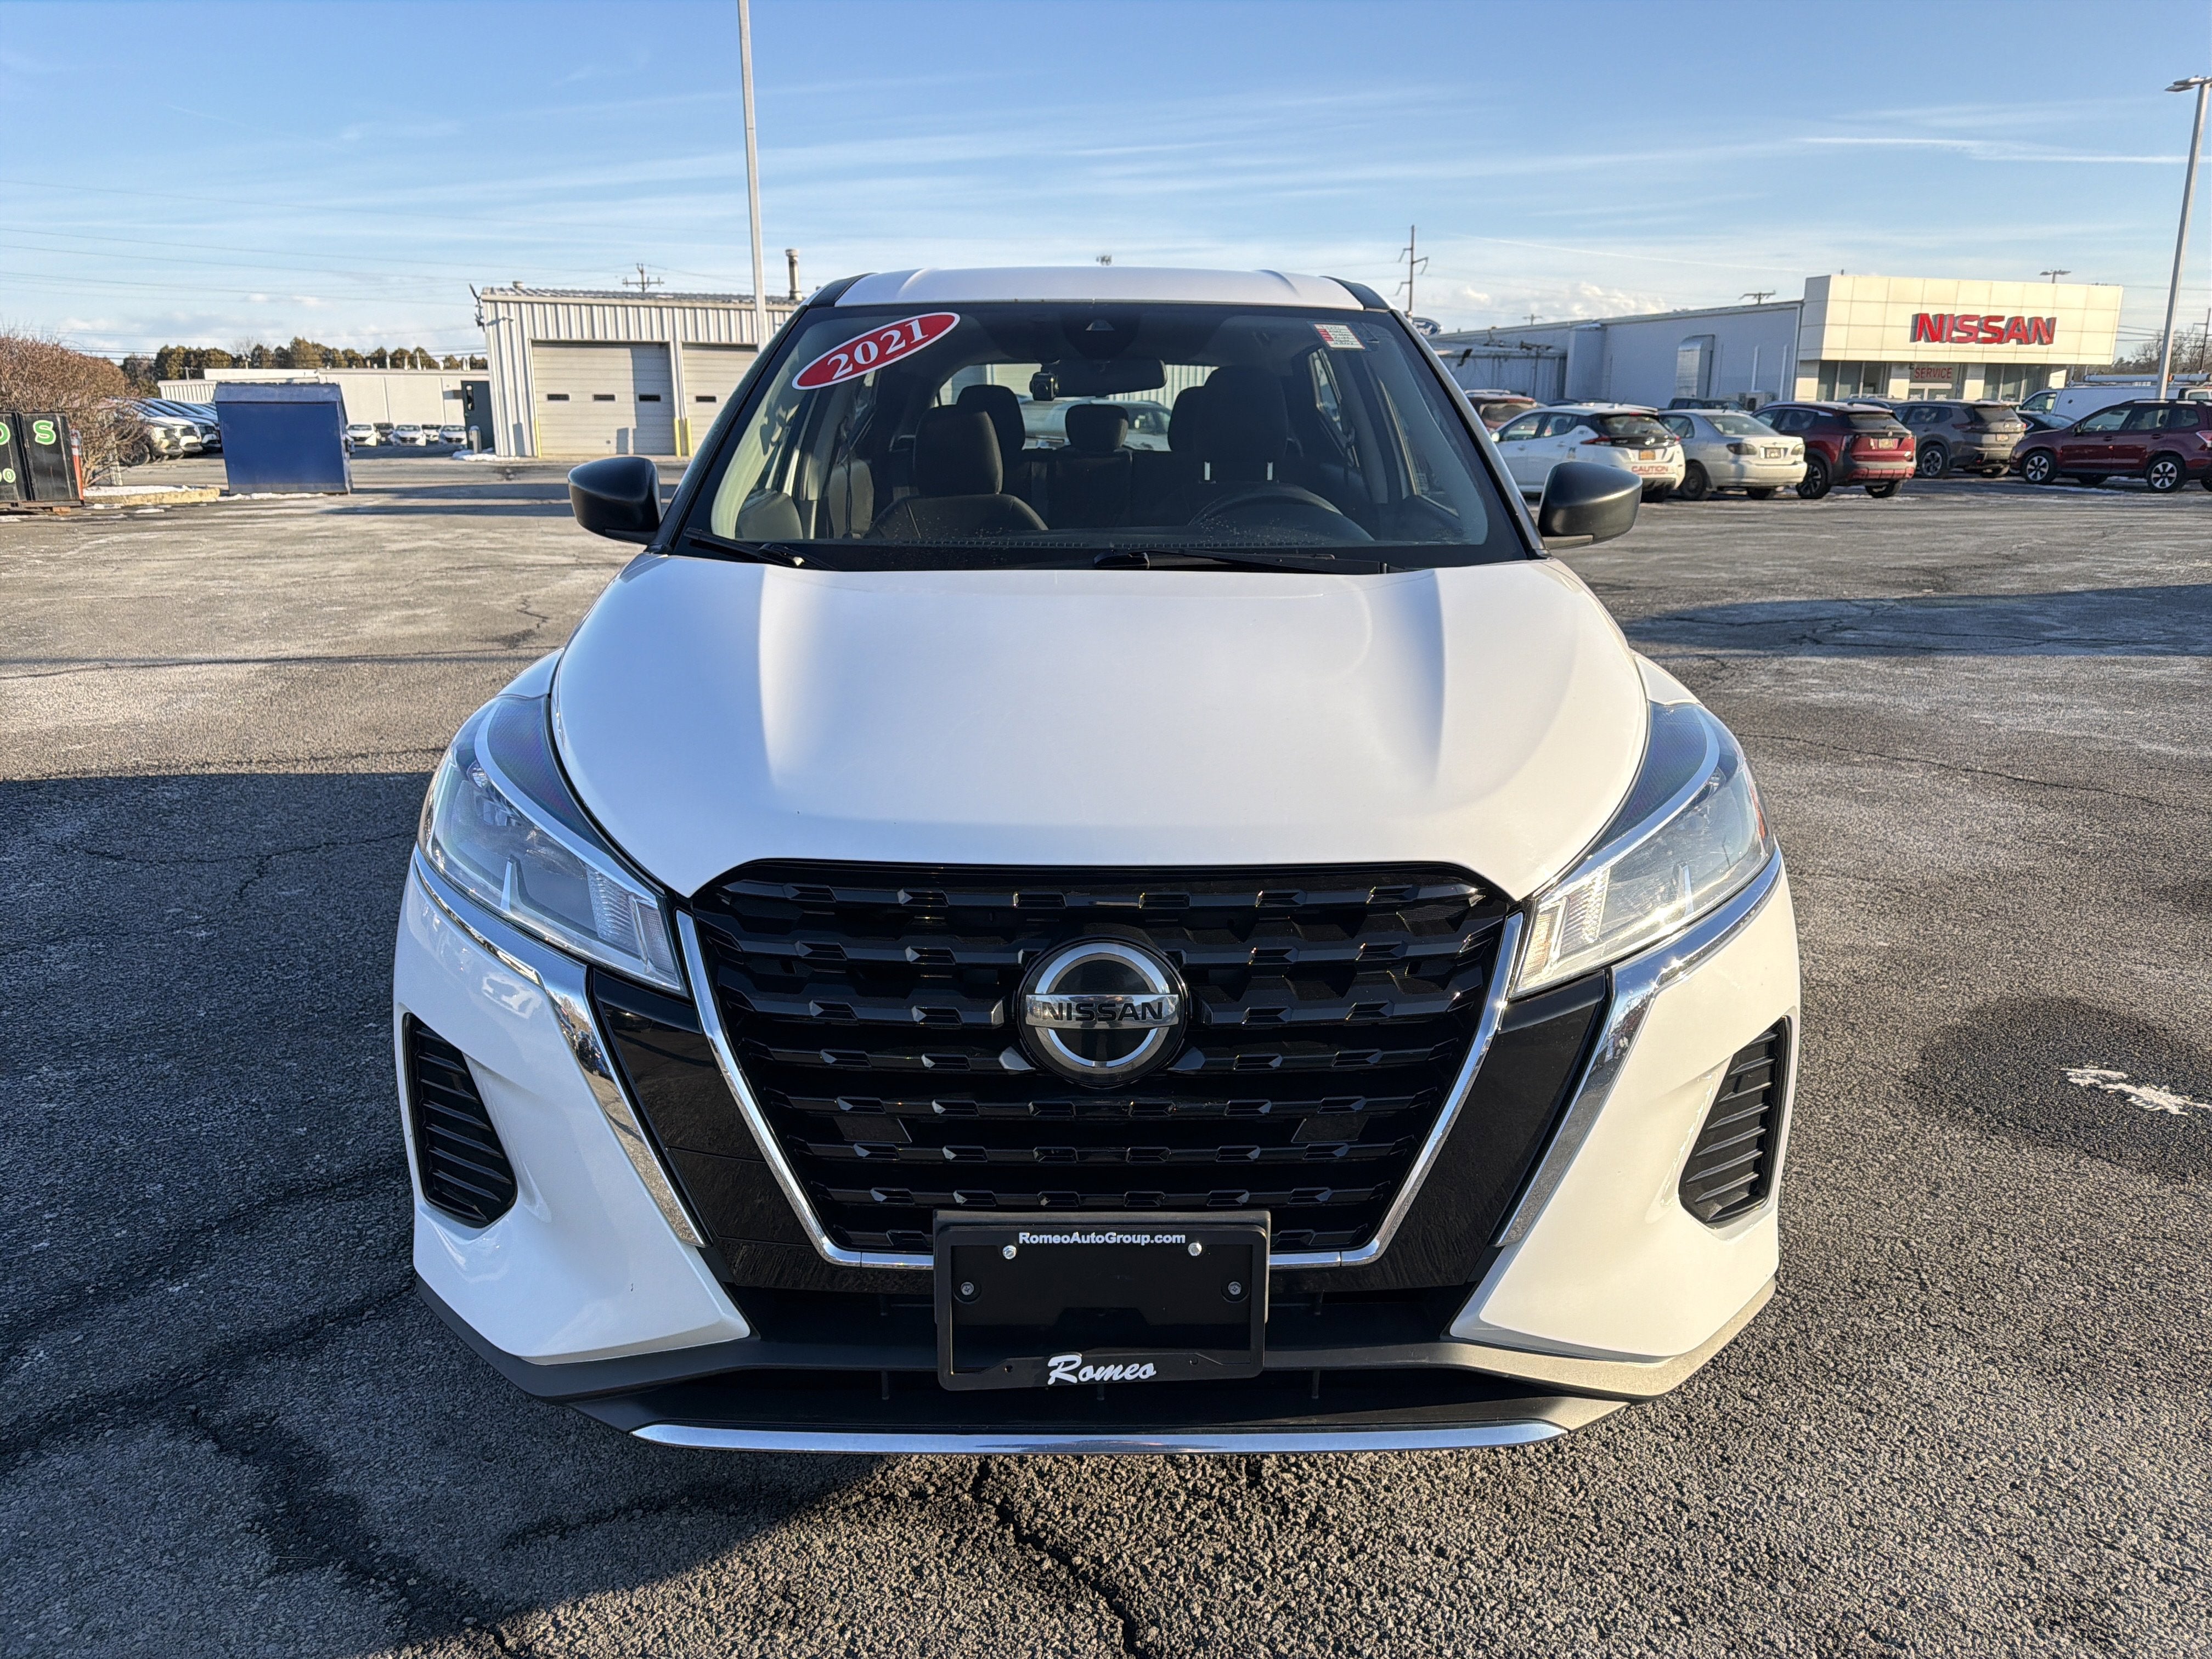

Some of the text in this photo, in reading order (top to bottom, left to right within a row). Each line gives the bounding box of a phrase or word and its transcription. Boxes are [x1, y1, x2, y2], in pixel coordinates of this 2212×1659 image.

[1909, 313, 2057, 345] NISSAN
[827, 319, 929, 380] 2021
[1914, 367, 1953, 379] SERVICE
[1043, 1002, 1163, 1022] NISSAN
[1019, 1232, 1186, 1246] RomeoAutoGroup.com
[1047, 1354, 1156, 1385] Romeo
